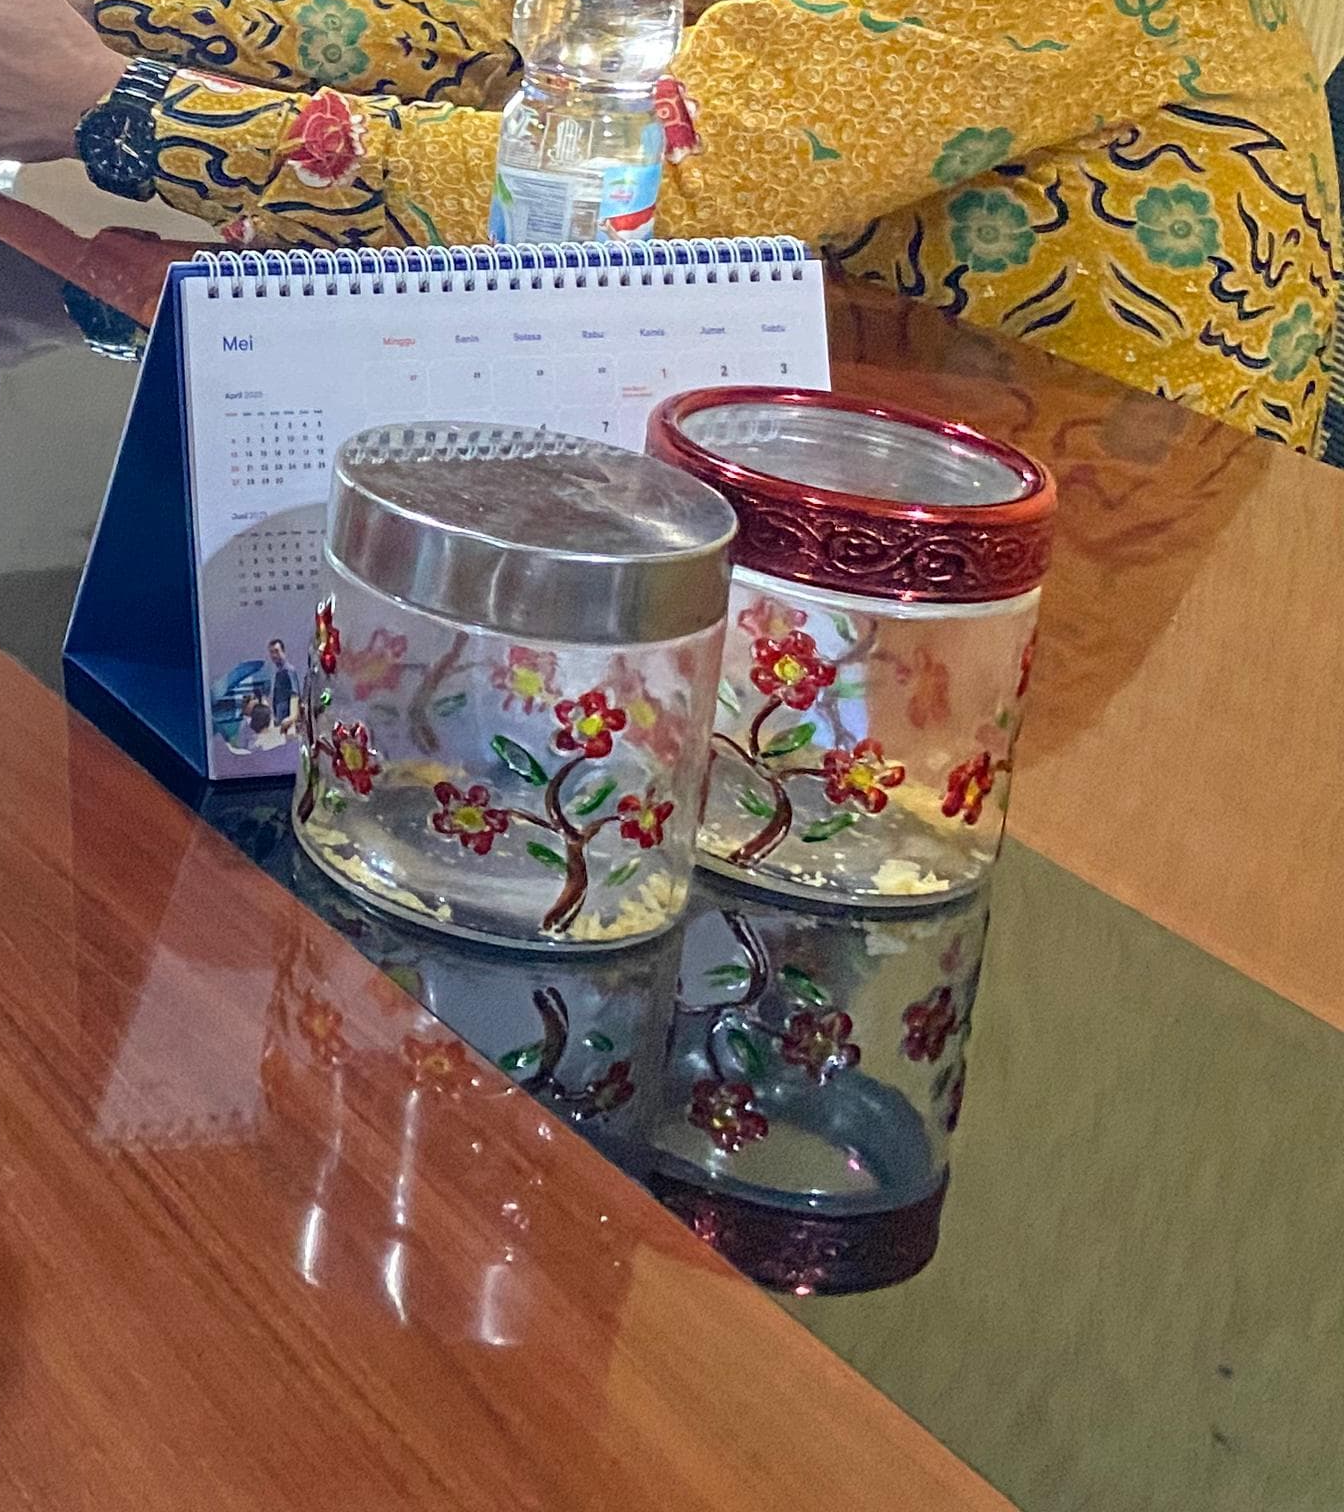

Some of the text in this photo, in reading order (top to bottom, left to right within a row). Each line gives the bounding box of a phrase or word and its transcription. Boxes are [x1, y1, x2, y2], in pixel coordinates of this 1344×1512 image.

[222, 334, 254, 352] Mei
[720, 364, 729, 377] 2
[780, 362, 788, 374] 3
[601, 420, 609, 433] 7
